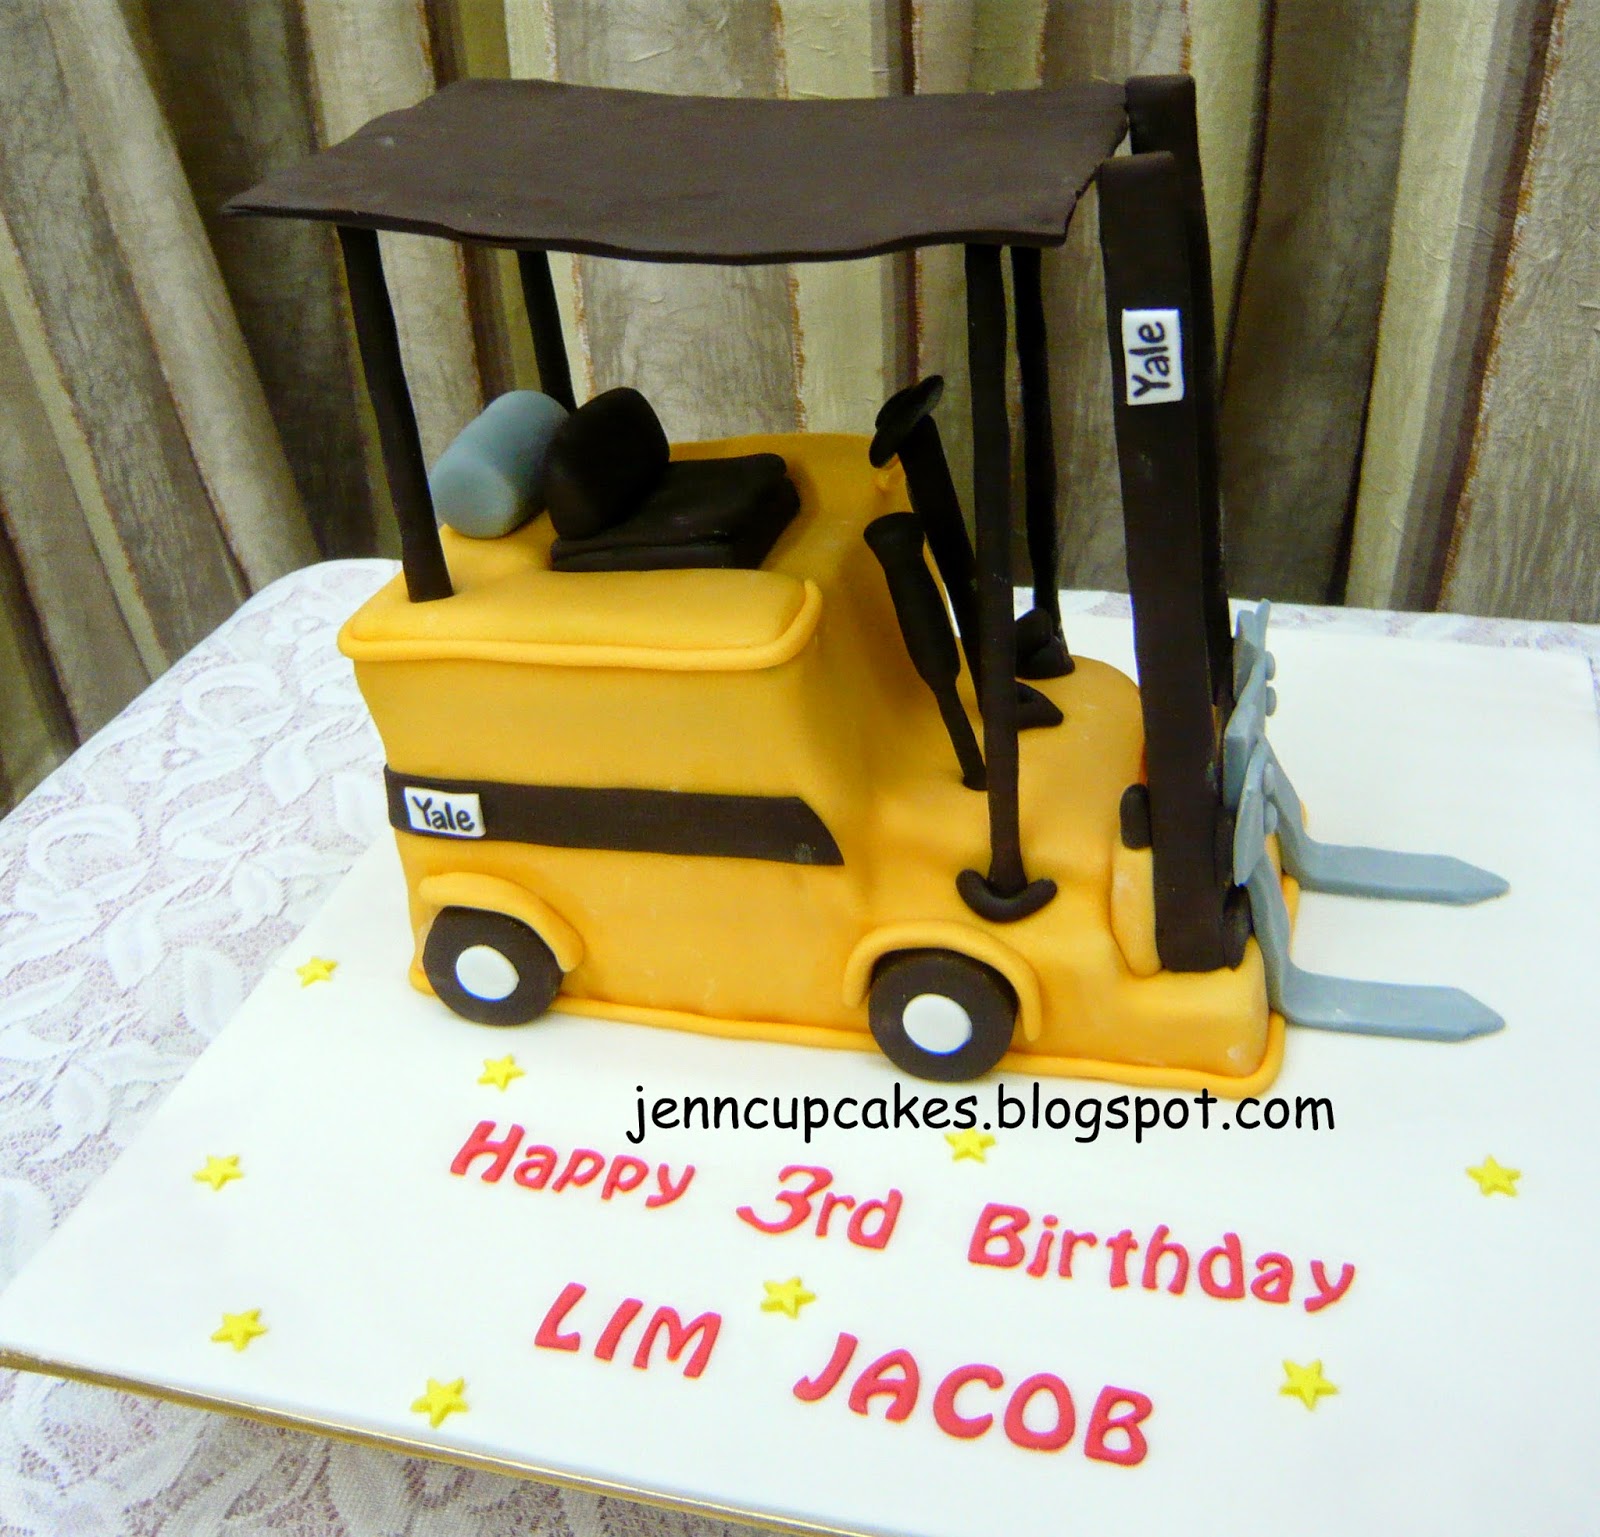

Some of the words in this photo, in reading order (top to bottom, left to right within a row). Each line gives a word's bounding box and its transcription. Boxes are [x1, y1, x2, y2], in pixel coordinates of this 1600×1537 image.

[1128, 321, 1171, 397] Yale
[412, 796, 475, 832] Yale
[450, 1121, 695, 1207] Happy
[737, 1166, 903, 1249] 3rd
[968, 1205, 1356, 1312] Birthday
[534, 1284, 722, 1377] LIM
[793, 1334, 1153, 1465] JACOB
